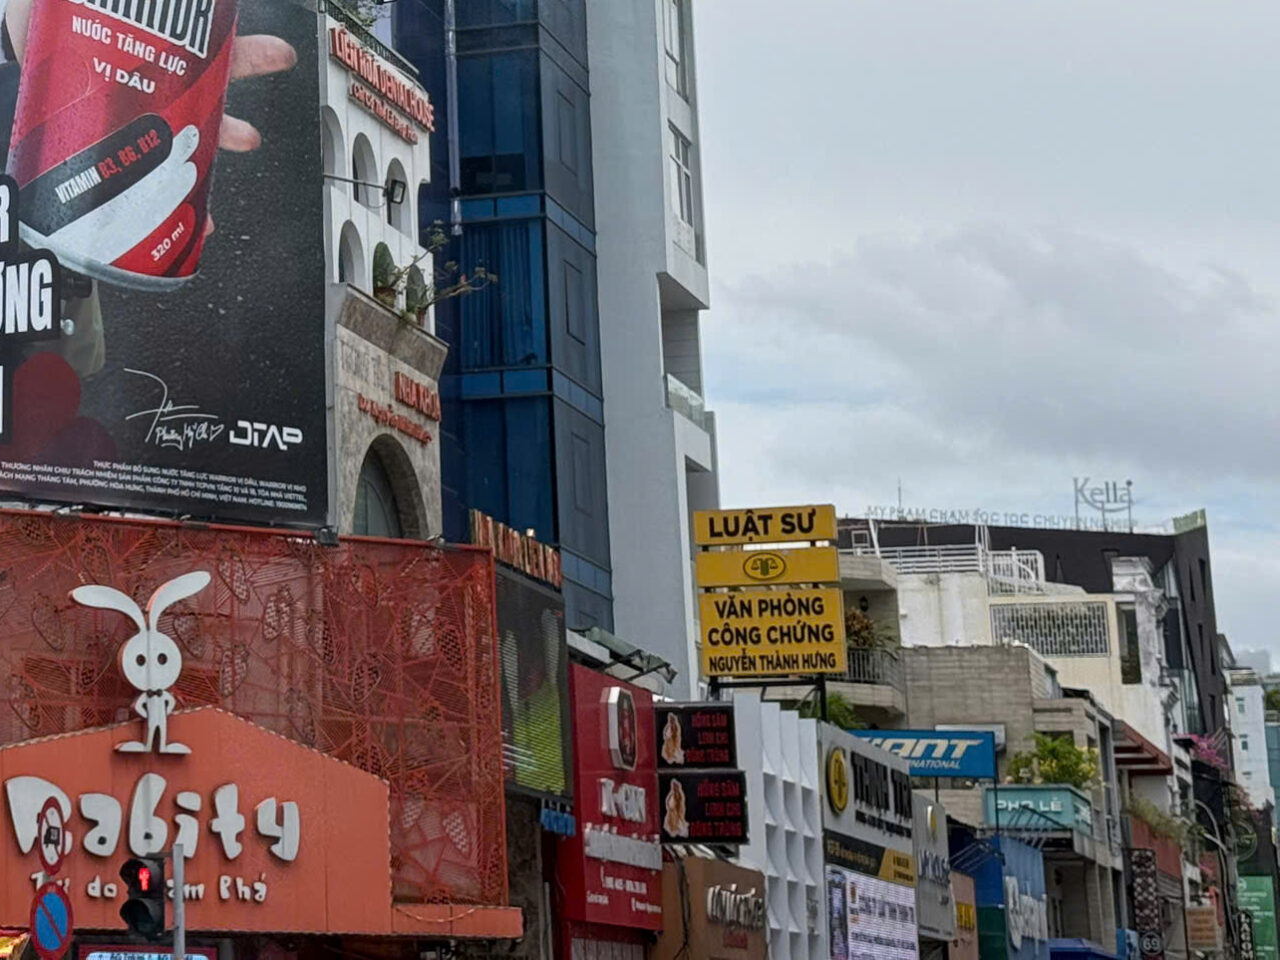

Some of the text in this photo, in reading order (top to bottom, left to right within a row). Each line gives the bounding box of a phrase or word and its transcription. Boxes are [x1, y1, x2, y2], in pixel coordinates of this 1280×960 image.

[72, 15, 188, 76] NƯỚC TĂNG LỰC
[93, 57, 156, 94] VỊ DÂU
[54, 166, 102, 204] VITAMIN
[150, 222, 185, 262] 320 ml
[709, 508, 816, 542] LUẬT SƯ
[714, 592, 824, 619] VĂN PHÒNG
[708, 620, 834, 646] CÔNG CHỨNG
[709, 648, 836, 672] NGUYỄN THÀNH HƯNG
[908, 759, 961, 770] NATIONAL
[4, 772, 300, 861] Rabity
[87, 875, 117, 898] do
[219, 872, 268, 903] Phá
